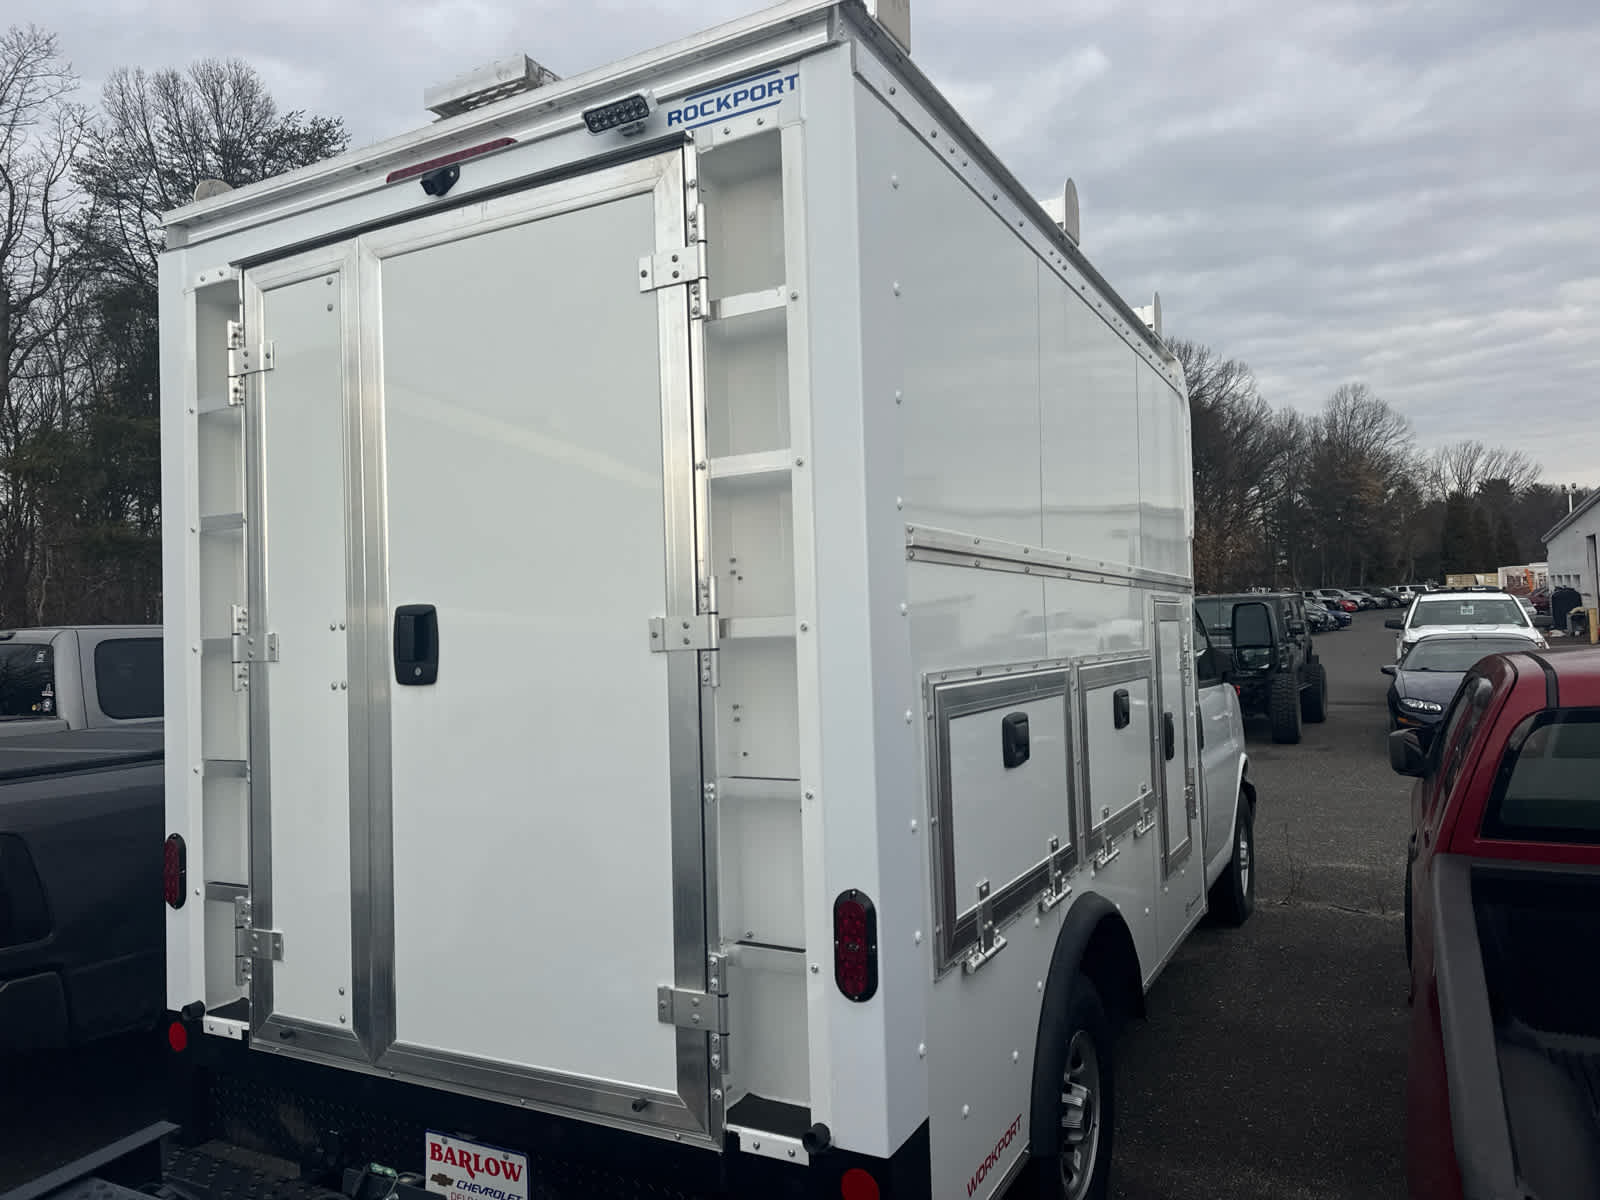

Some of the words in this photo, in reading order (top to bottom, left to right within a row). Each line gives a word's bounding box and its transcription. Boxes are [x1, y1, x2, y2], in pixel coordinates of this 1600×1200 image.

[667, 72, 800, 127] ROCKPORT
[429, 1141, 523, 1182] BARLOW
[967, 1113, 1022, 1198] WORKPORT
